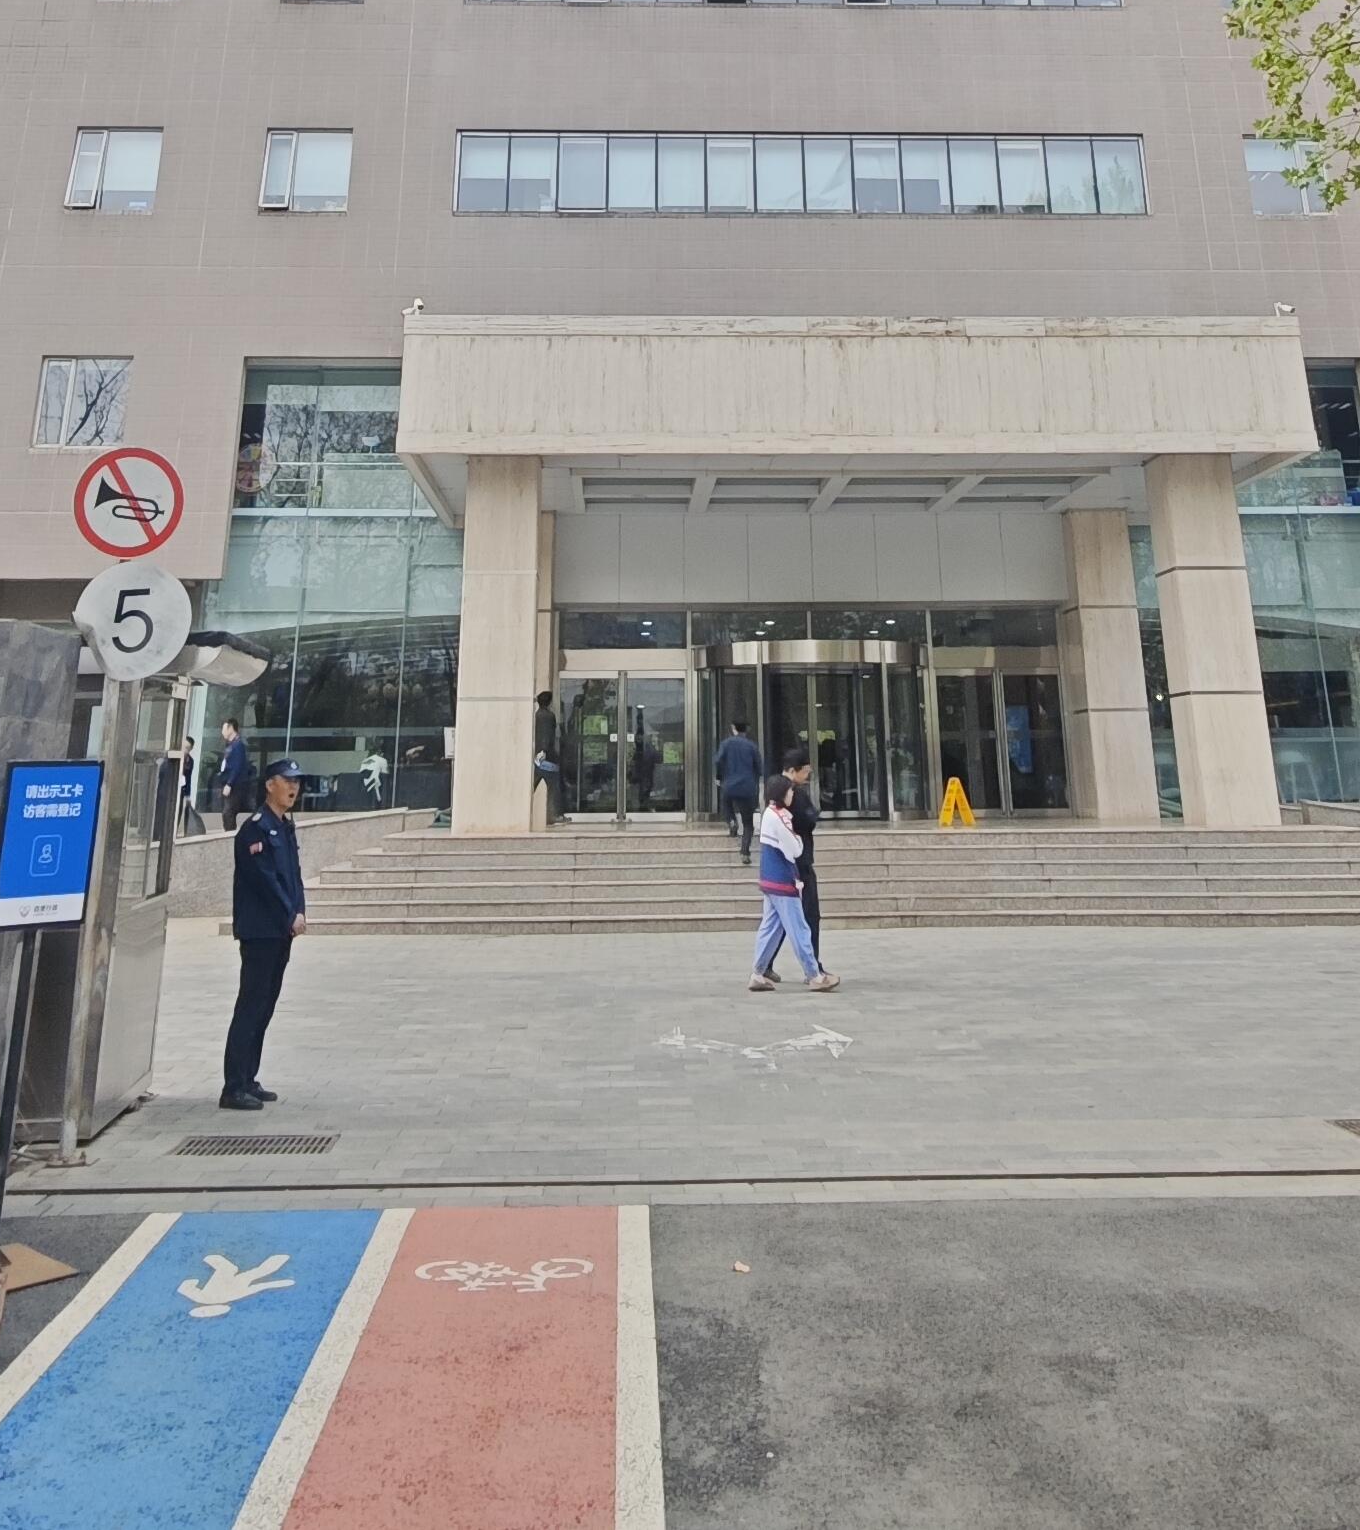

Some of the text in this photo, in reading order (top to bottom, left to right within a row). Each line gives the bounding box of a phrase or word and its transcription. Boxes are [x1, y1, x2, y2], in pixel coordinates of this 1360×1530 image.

[112, 588, 153, 653] 5
[25, 785, 84, 799] 请出示工卡
[23, 803, 82, 818] 访客需登记
